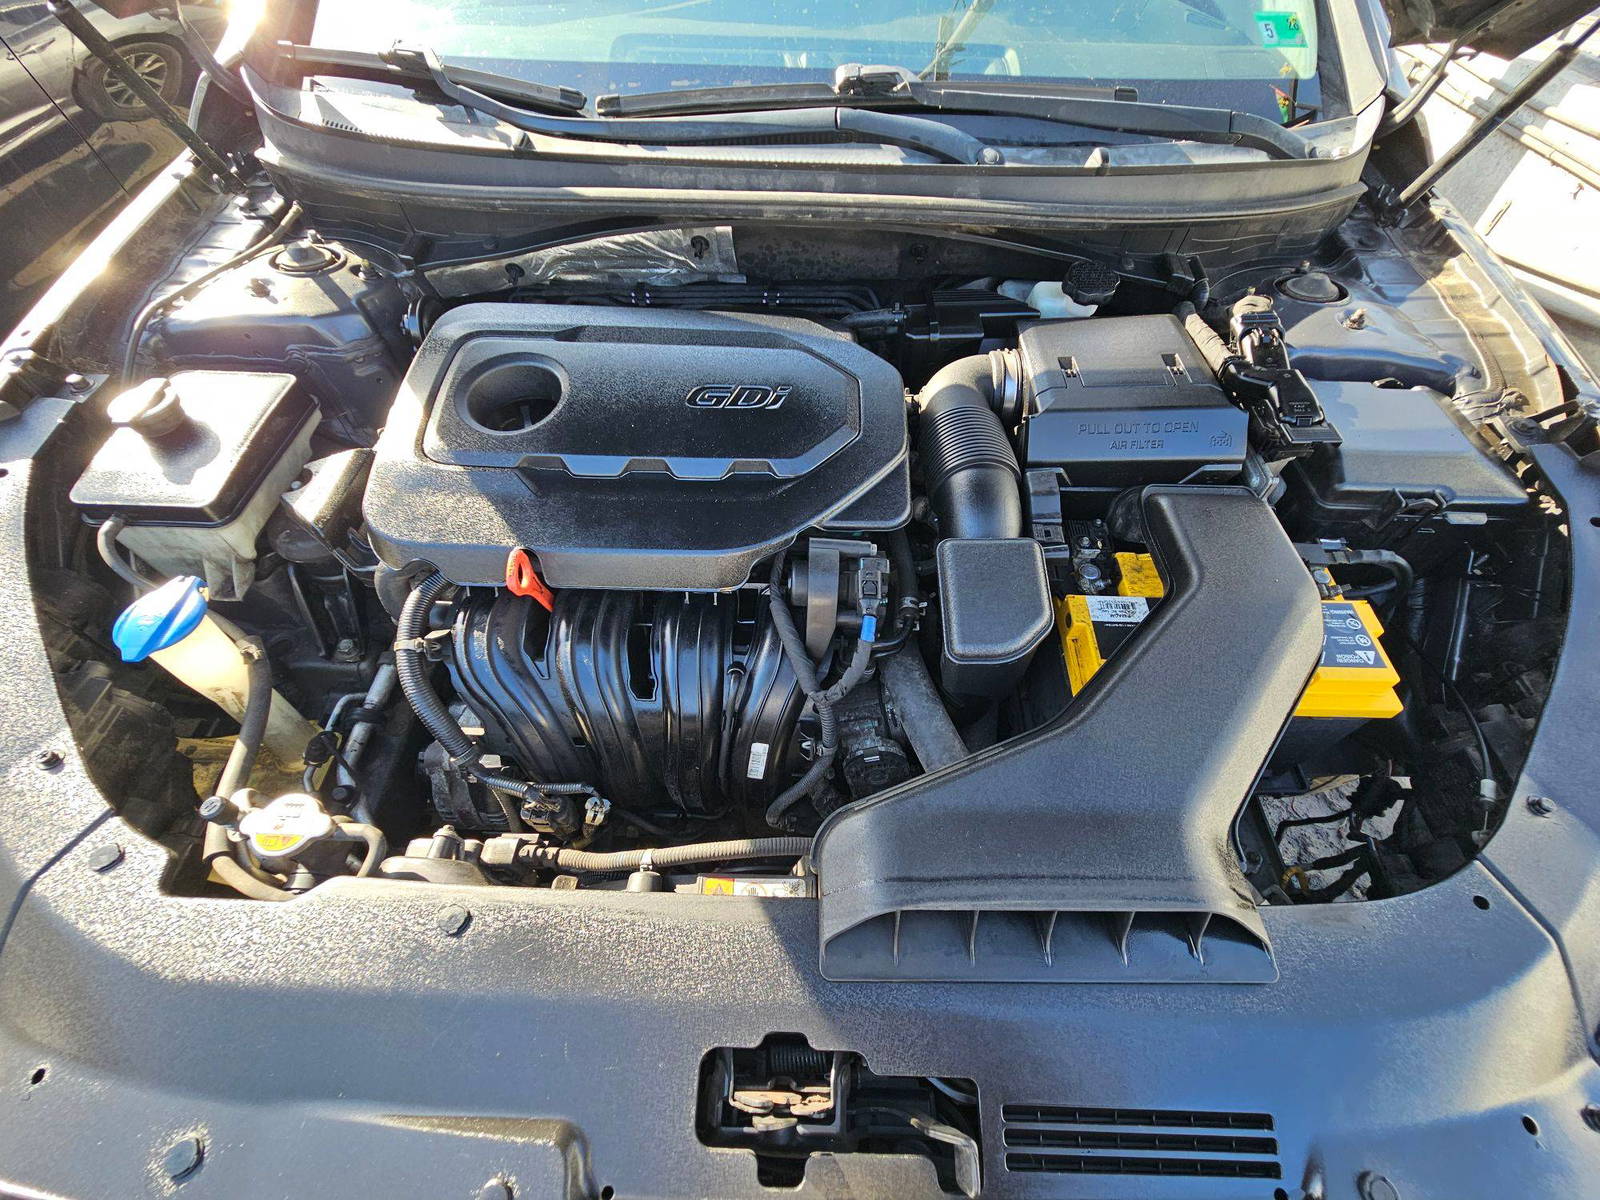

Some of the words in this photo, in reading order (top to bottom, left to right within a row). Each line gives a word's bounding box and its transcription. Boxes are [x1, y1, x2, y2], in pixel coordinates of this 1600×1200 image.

[1263, 23, 1274, 38] 5
[685, 384, 793, 409] GDi
[1078, 422, 1110, 435] PULL
[1114, 422, 1141, 434] OUT
[1143, 422, 1161, 434] TO
[1163, 420, 1199, 433] OPEN
[1110, 439, 1128, 450] AIR
[1130, 439, 1165, 450] FILTER
